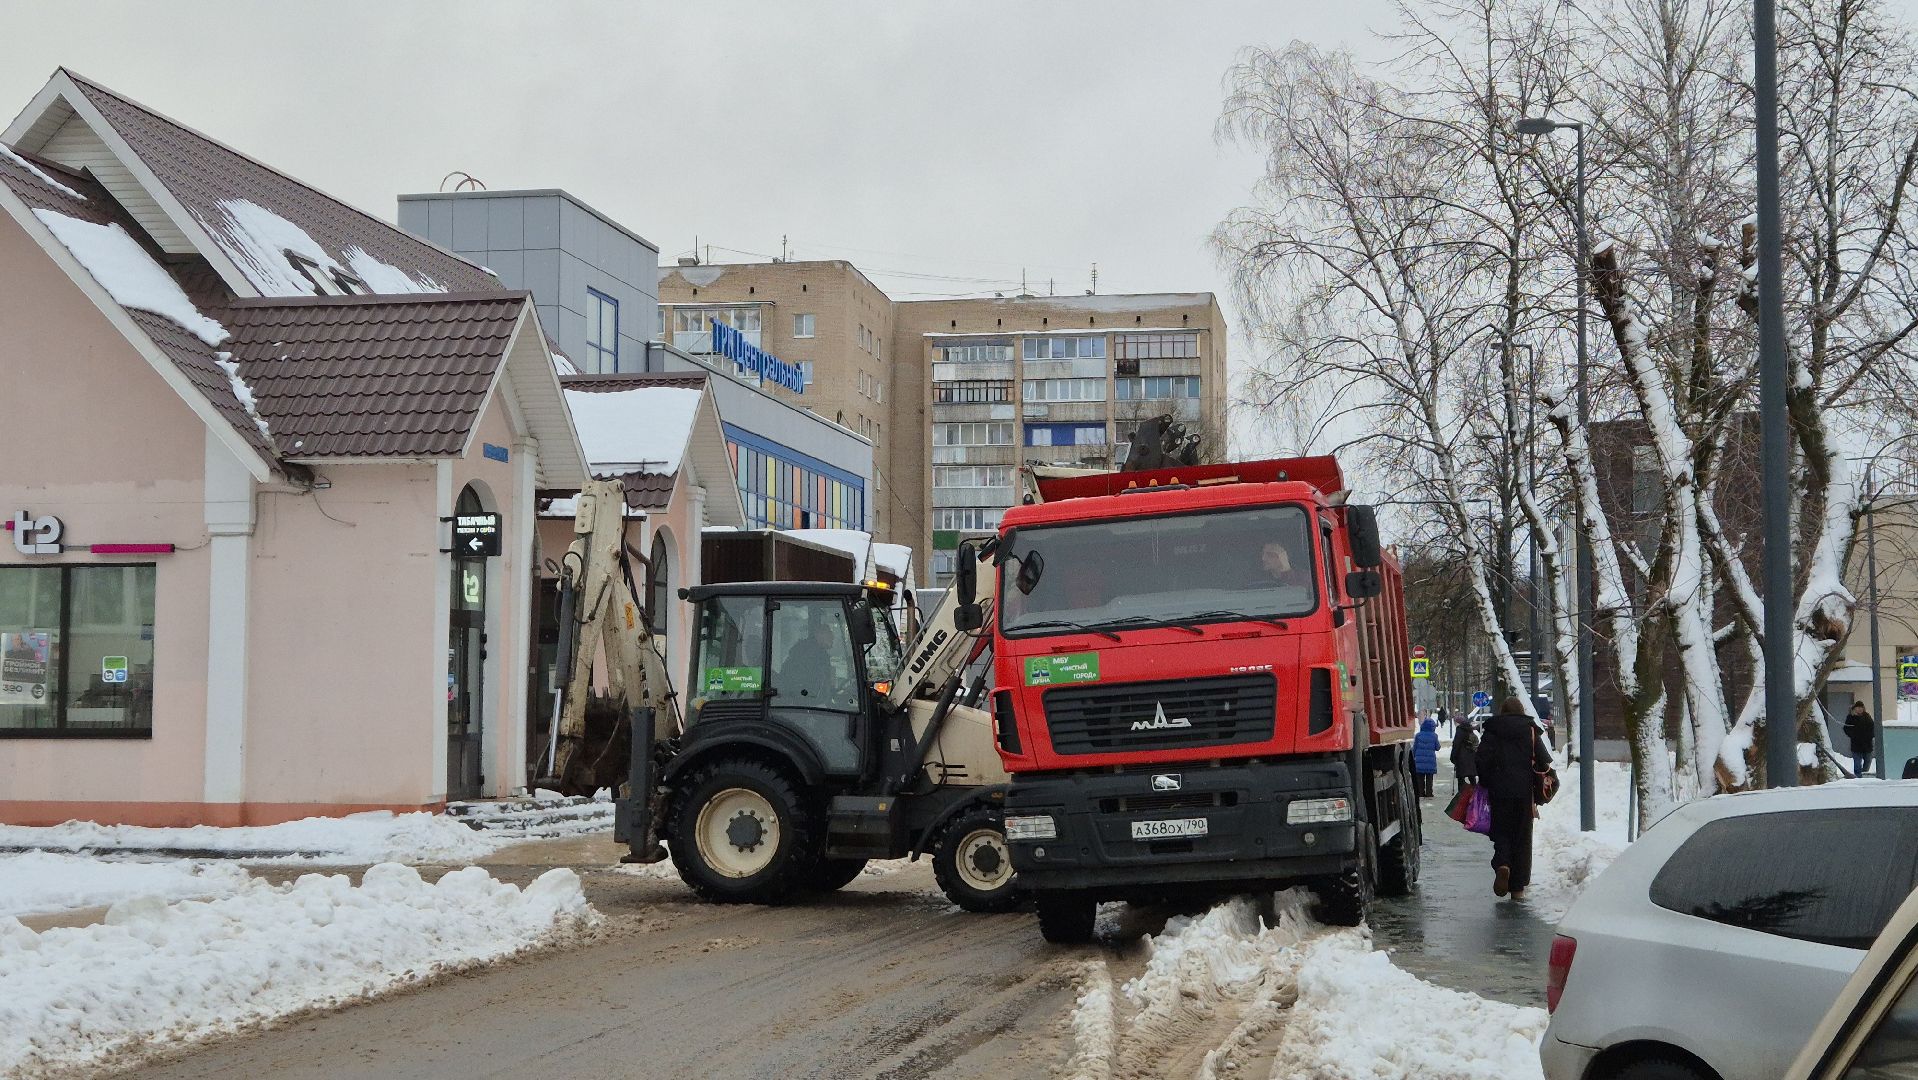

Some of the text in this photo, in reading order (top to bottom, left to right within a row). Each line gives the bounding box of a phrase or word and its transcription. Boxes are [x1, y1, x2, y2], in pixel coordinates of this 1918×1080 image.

[735, 329, 804, 394] Центральный
[457, 515, 496, 527] ТАБАЧНЫЙ
[910, 629, 948, 674] UMG
[1052, 656, 1069, 665] МБУ
[1187, 819, 1204, 830] 790
